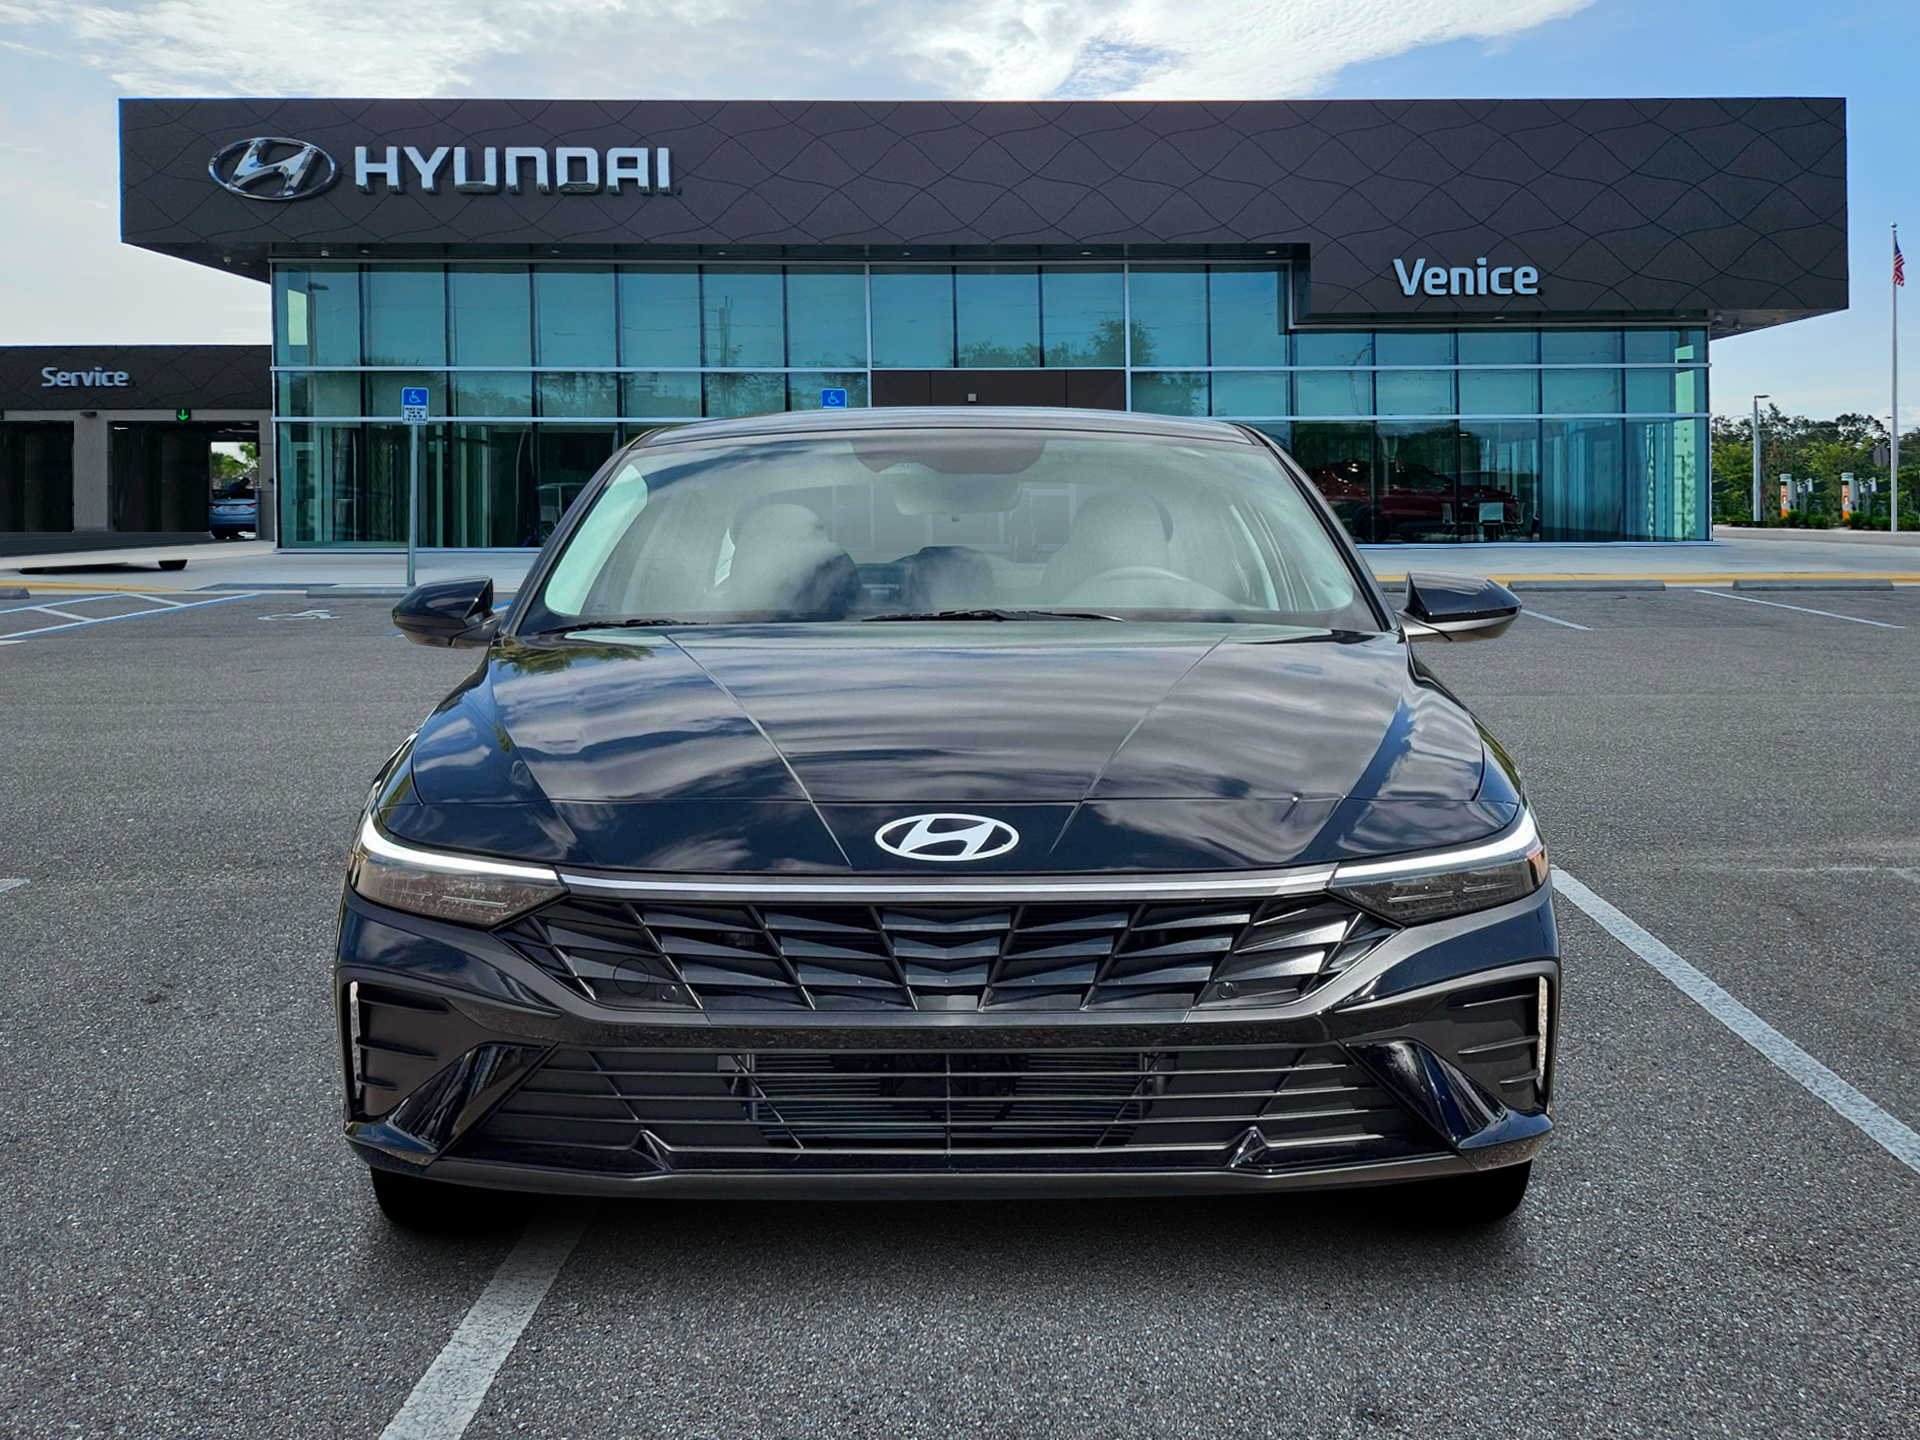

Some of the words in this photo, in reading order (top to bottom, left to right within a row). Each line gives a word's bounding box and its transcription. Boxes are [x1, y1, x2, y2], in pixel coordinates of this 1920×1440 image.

[354, 146, 670, 195] HYUNDAI
[1392, 257, 1540, 296] Venice
[41, 366, 130, 387] Service
